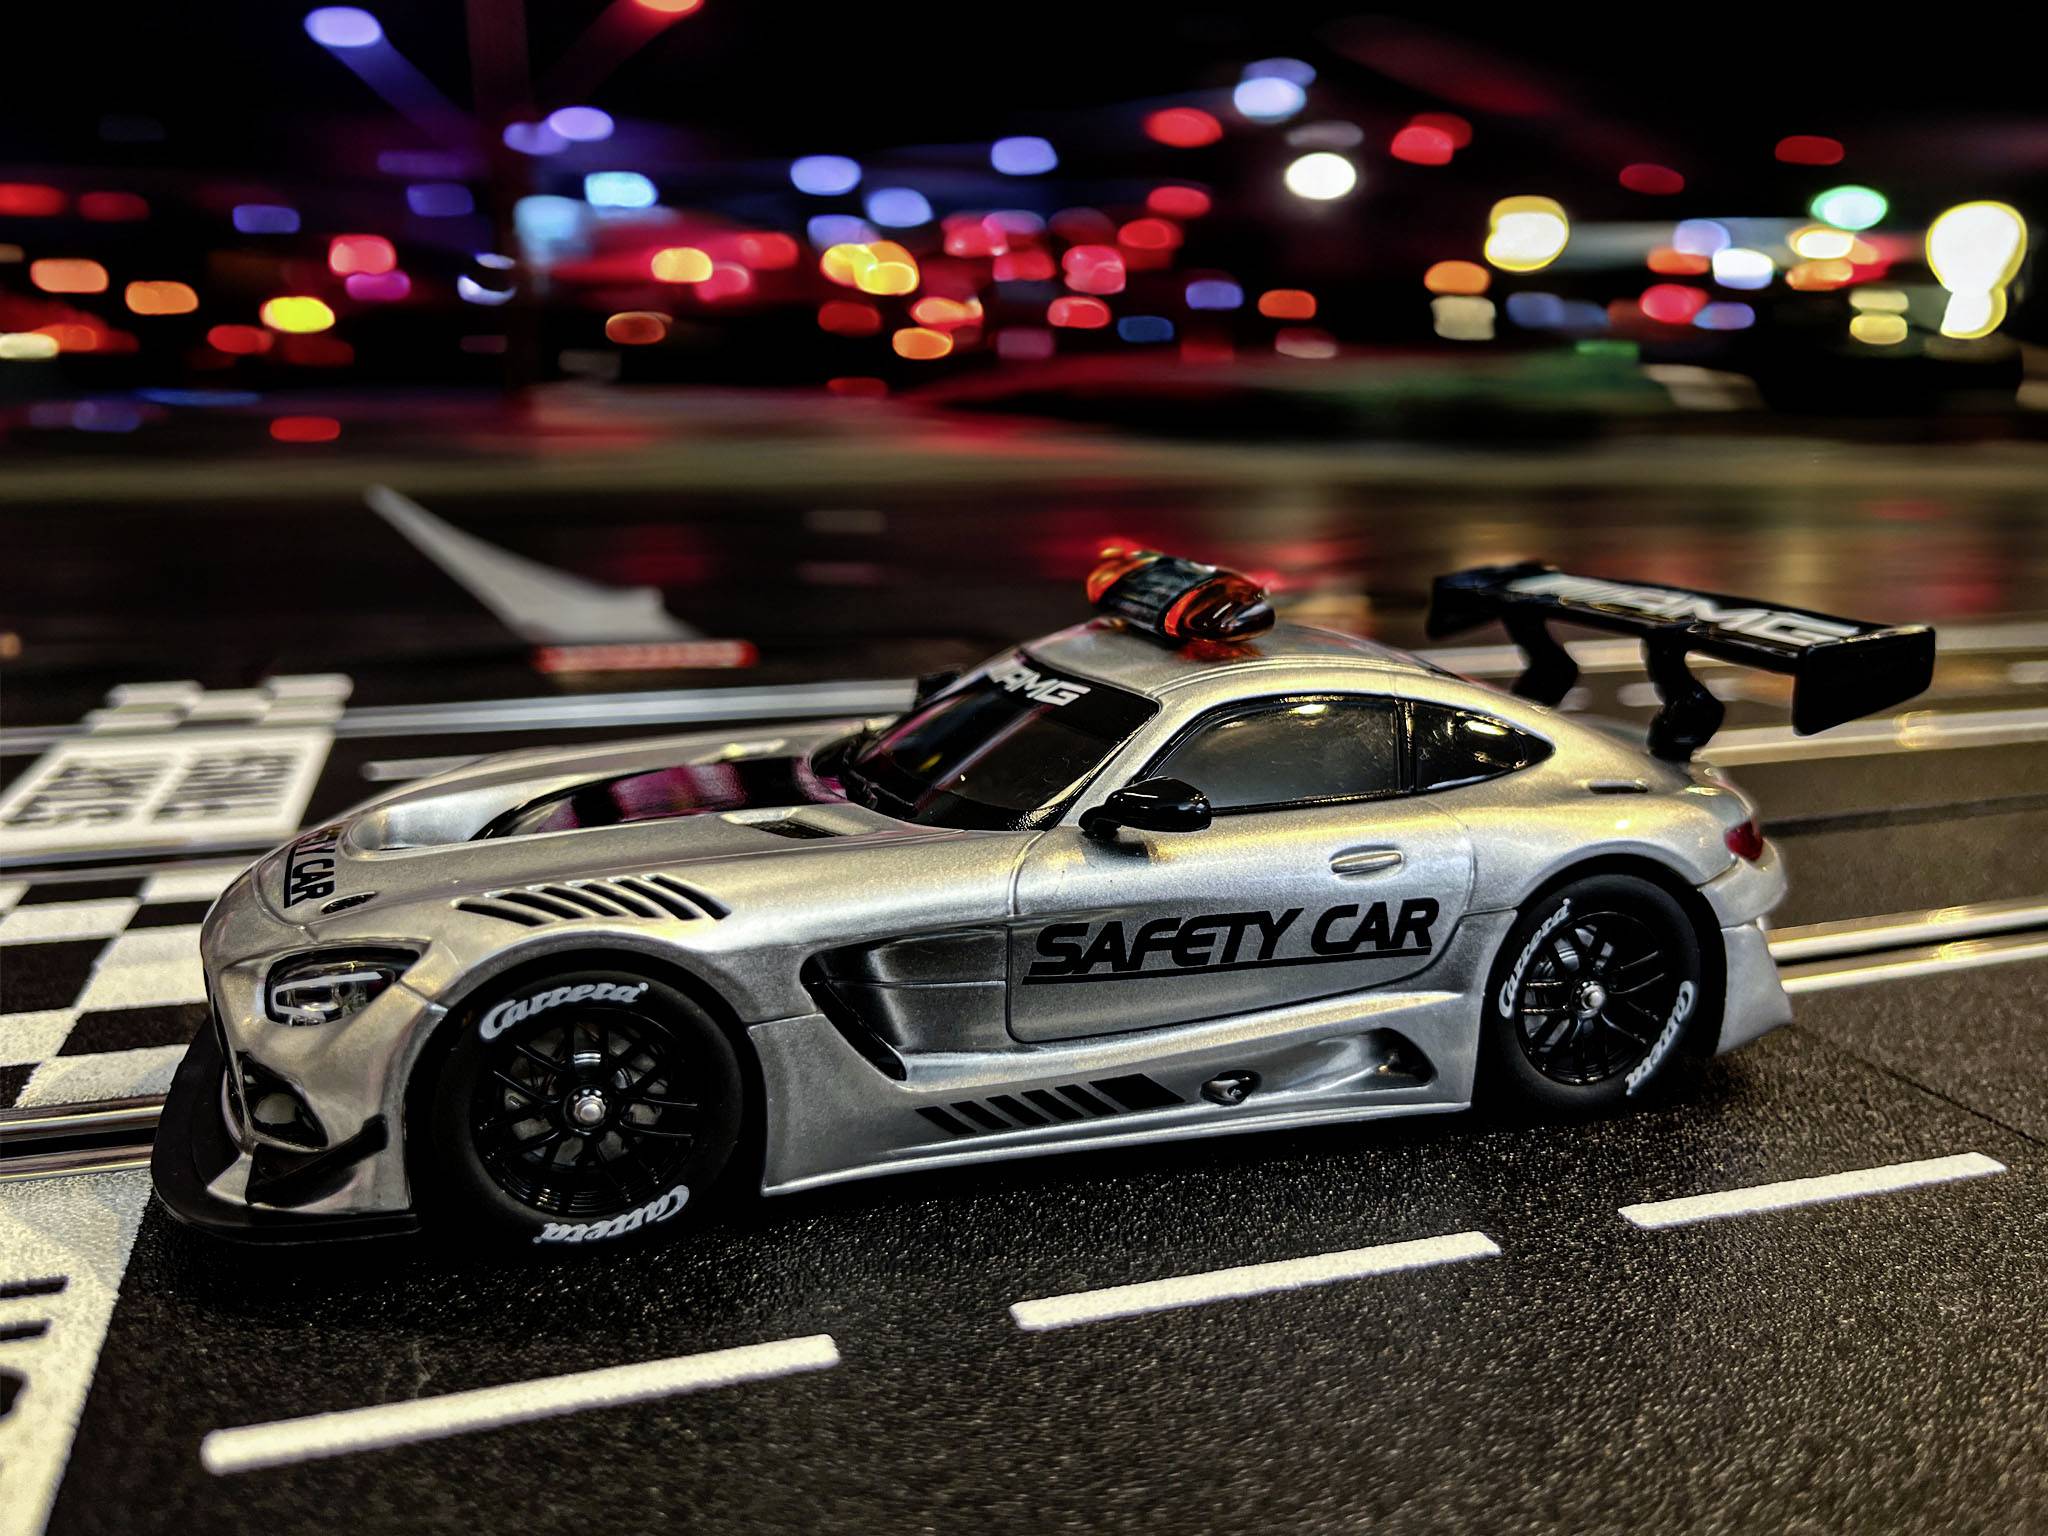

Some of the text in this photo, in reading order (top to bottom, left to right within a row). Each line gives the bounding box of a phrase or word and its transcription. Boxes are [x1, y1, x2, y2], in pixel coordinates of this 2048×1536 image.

[290, 859, 335, 906] CAR
[1029, 897, 1440, 975] SAFETY CAR
[480, 982, 648, 1040] Carrera
[532, 1185, 690, 1243] Carrera
